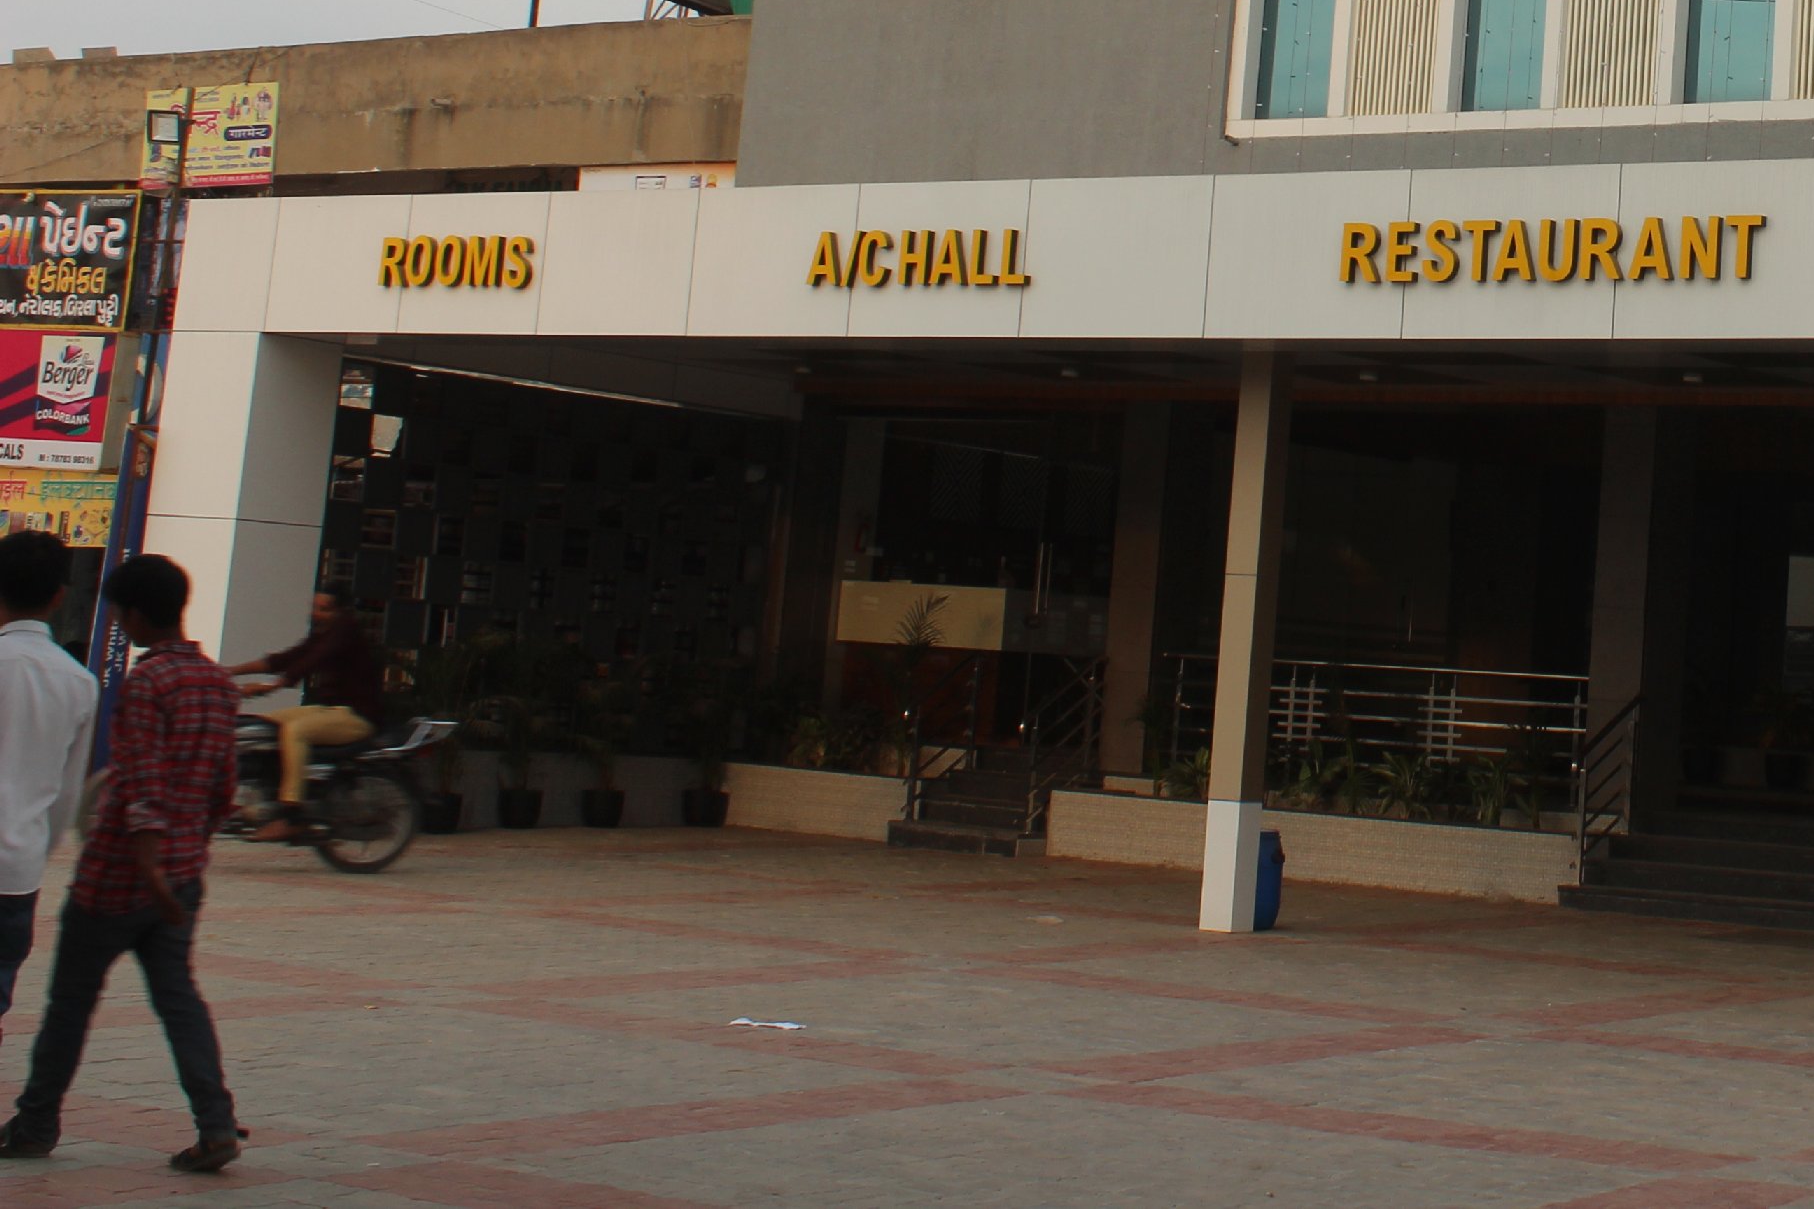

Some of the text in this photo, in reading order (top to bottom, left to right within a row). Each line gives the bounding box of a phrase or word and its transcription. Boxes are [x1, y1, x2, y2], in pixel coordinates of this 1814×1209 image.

[378, 235, 534, 288] ROOMS
[806, 229, 1031, 287] A/C HALL
[1339, 214, 1766, 284] RESTAURANT
[42, 361, 95, 392] Berger
[36, 408, 90, 426] COLORBANK
